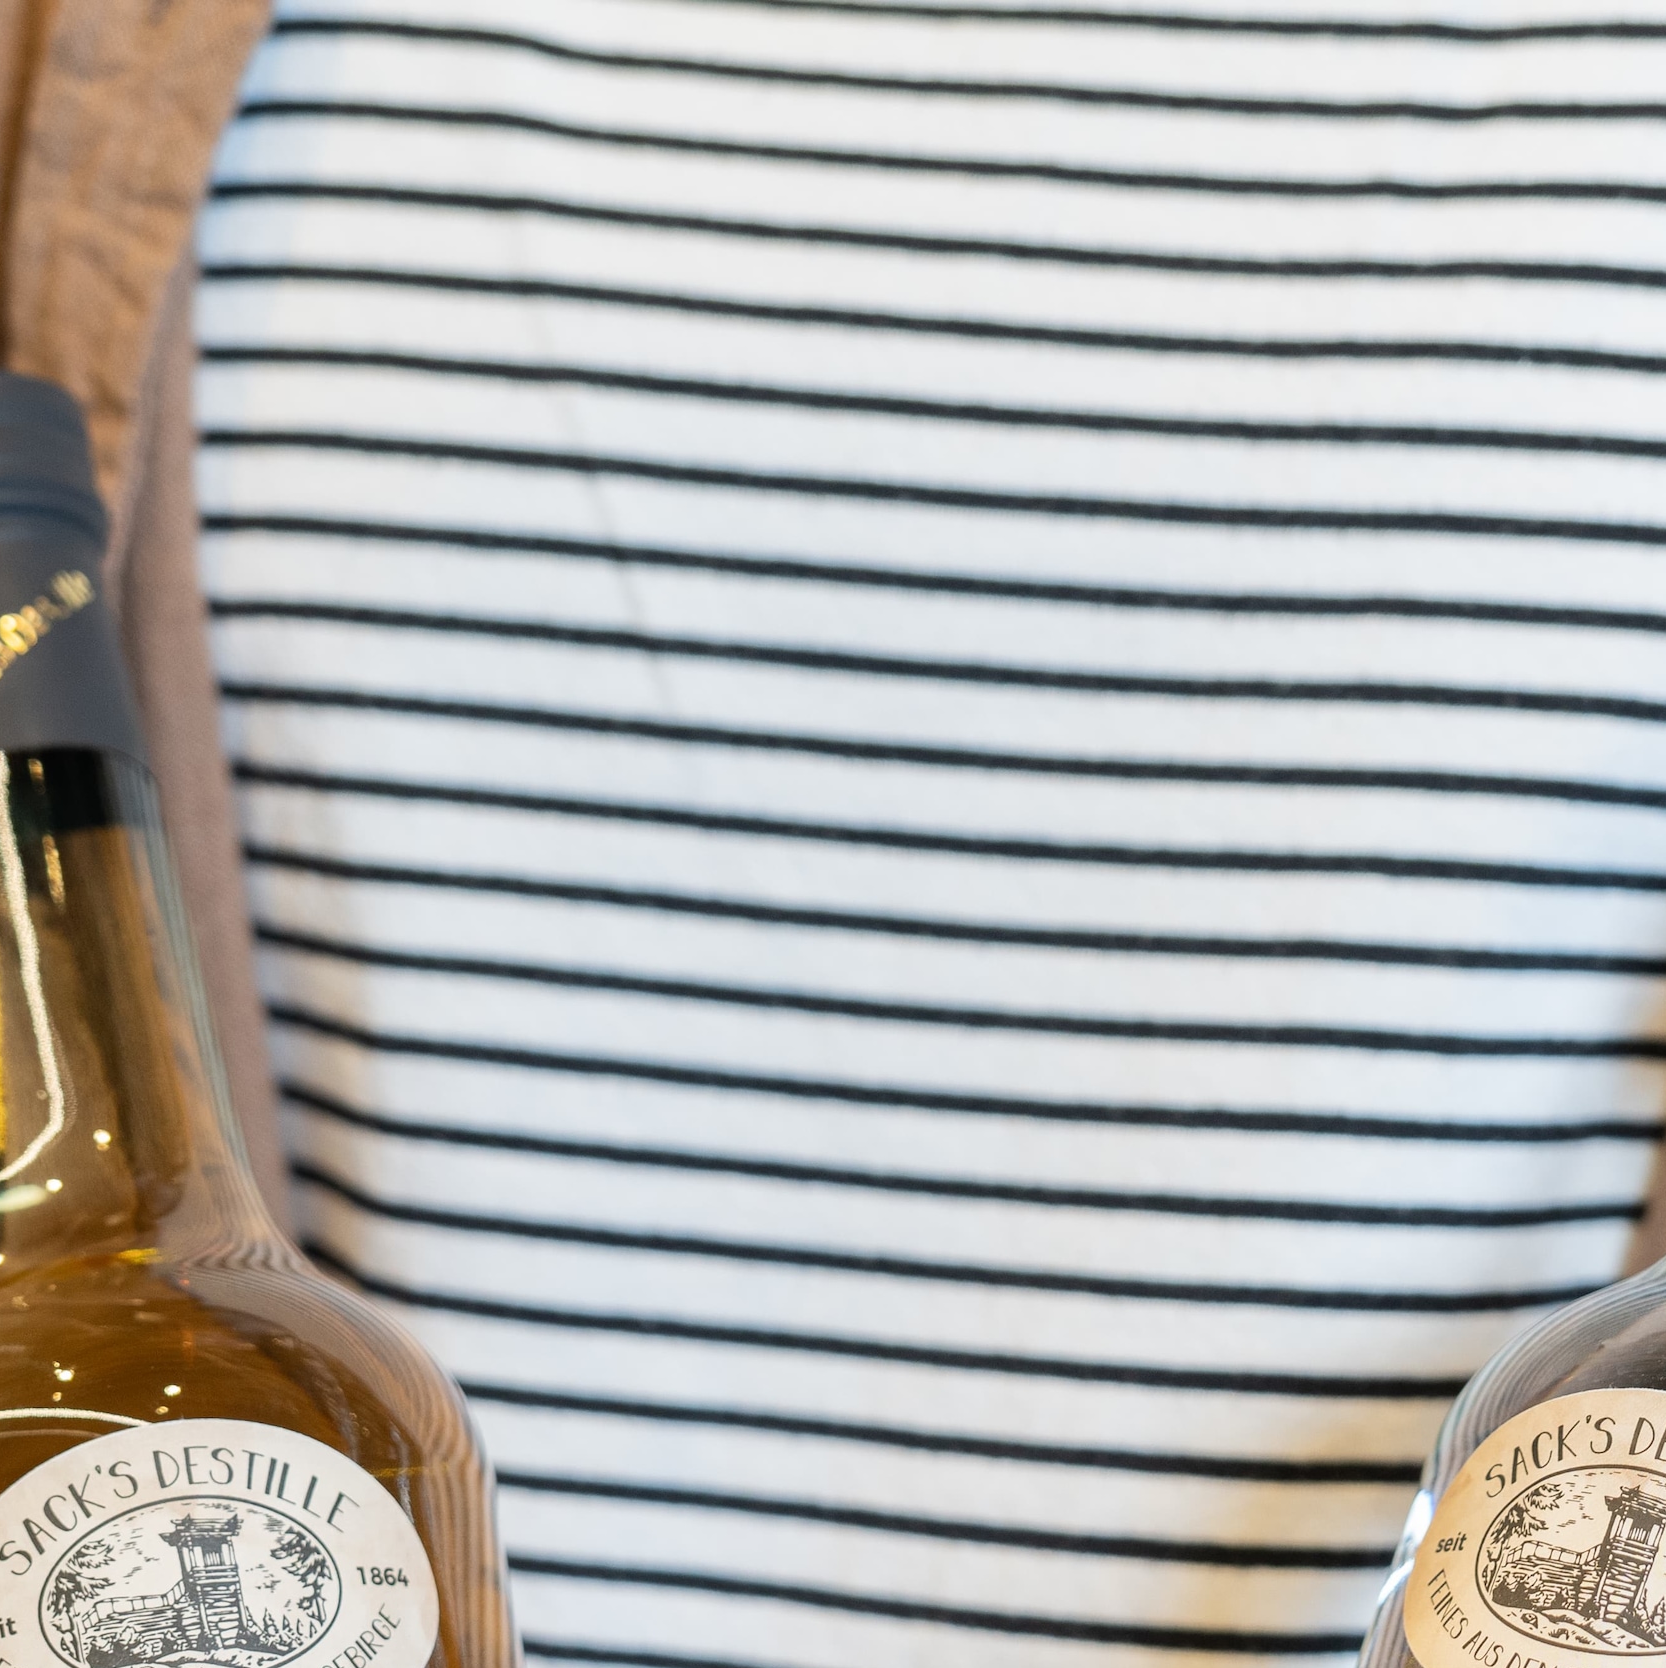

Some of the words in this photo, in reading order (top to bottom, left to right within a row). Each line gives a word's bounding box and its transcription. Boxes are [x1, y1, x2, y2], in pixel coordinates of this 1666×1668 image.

[1484, 1413, 1618, 1498] SACK'S
[0, 1460, 139, 1577] SACK'S
[153, 1445, 360, 1534] DESTILLE
[1435, 1531, 1467, 1554] seit
[356, 1566, 410, 1587] 1864
[1427, 1567, 1469, 1641] FEINES
[1463, 1633, 1505, 1668] AUS
